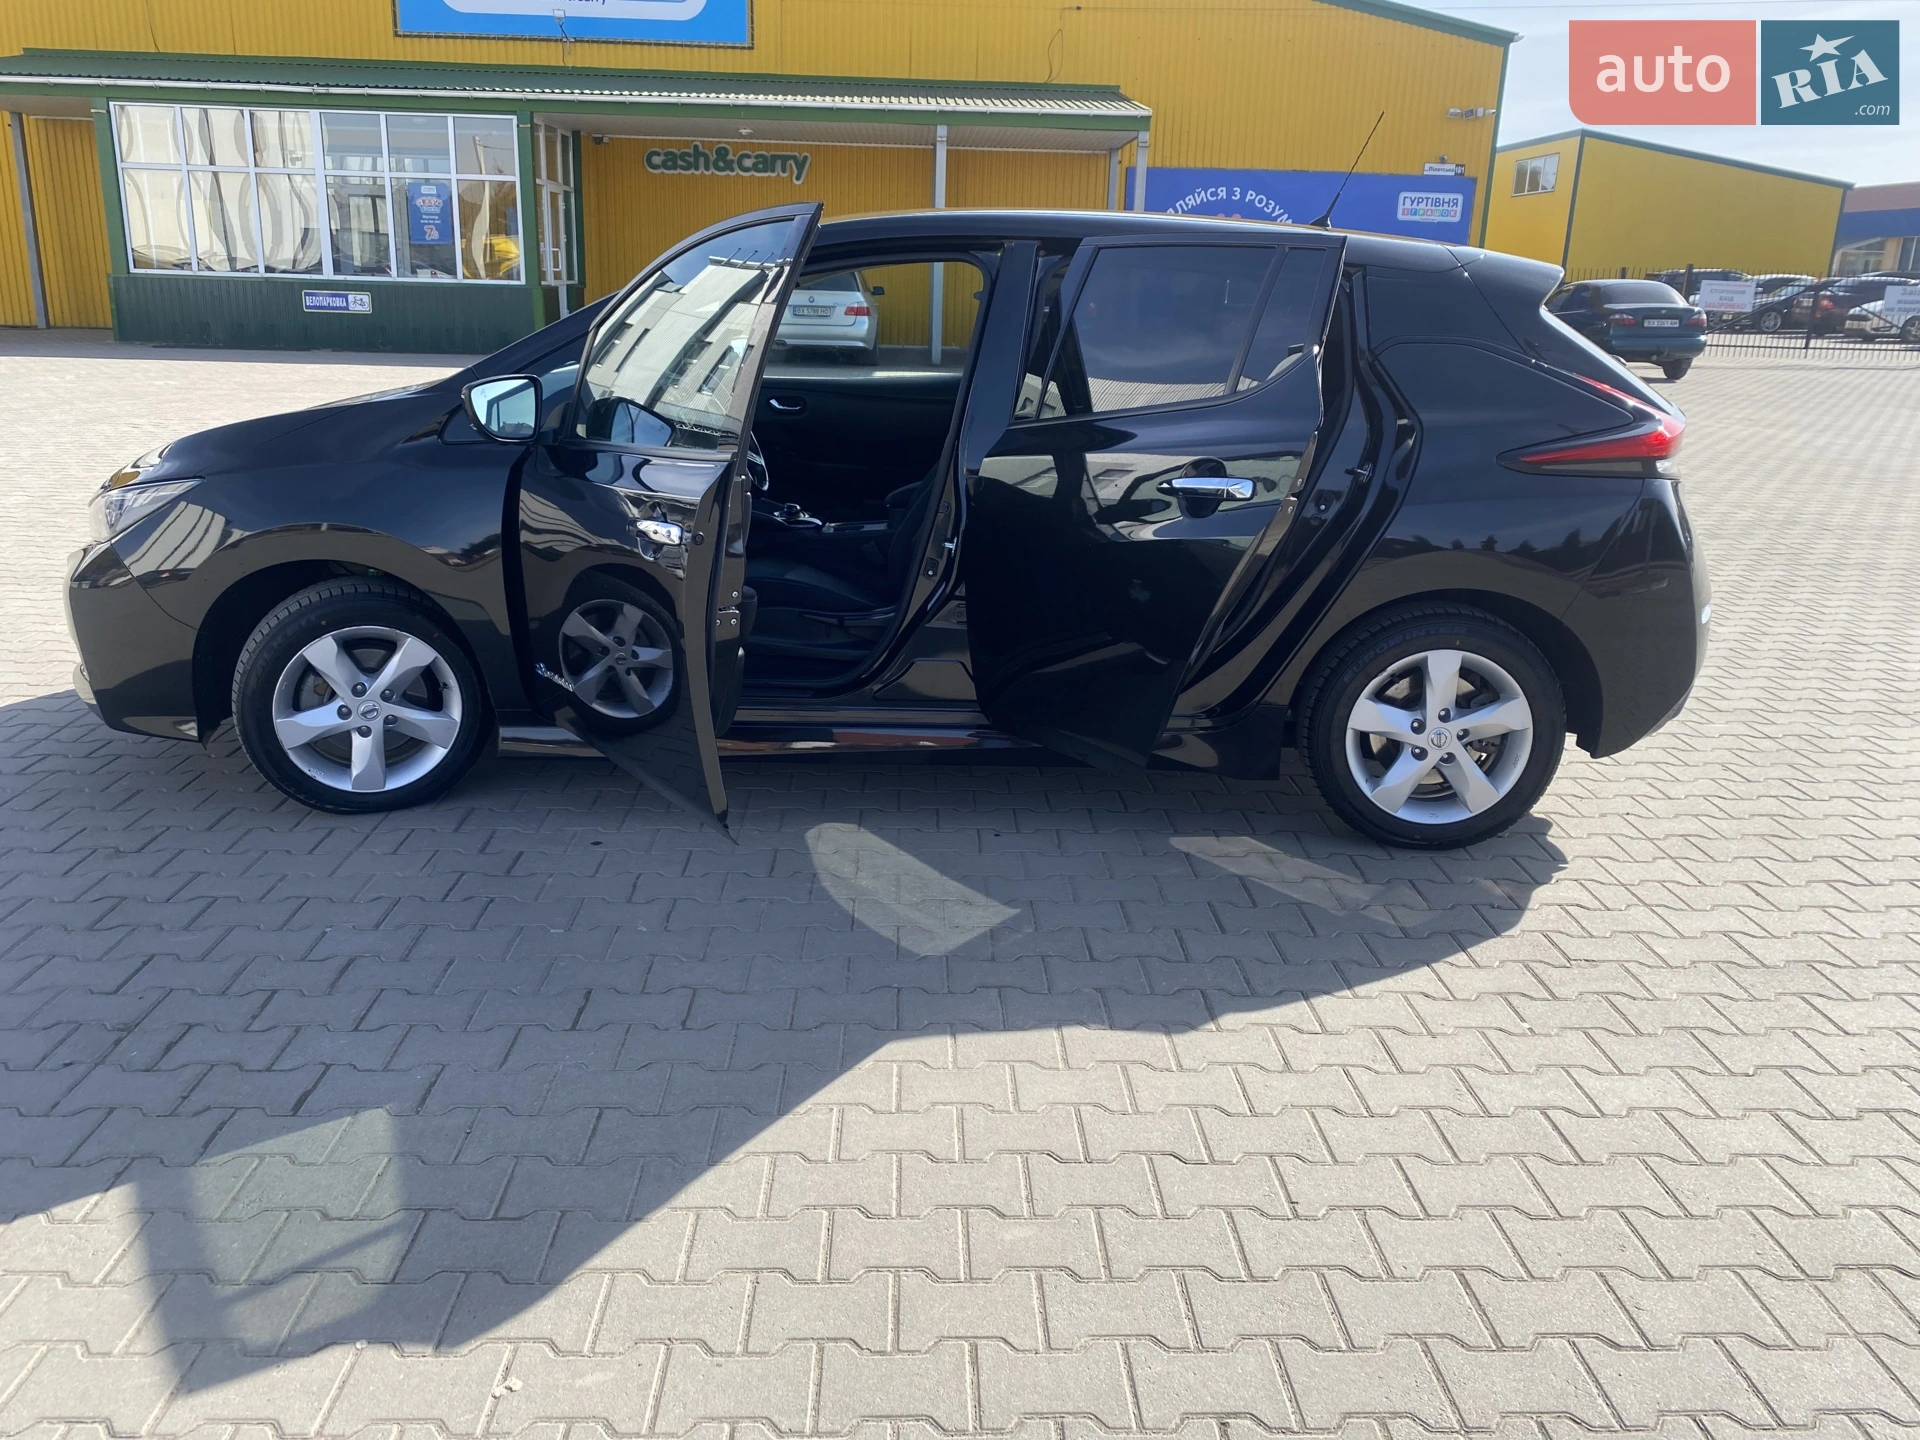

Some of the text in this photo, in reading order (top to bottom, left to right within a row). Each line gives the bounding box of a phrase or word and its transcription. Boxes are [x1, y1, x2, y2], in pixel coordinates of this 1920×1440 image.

[645, 143, 810, 182] cash&carry
[1402, 196, 1459, 208] ГУРТІВНЯ
[1402, 208, 1457, 217] ІГРАШОК
[305, 295, 347, 307] ВЕЛОПАРКОВКА
[1343, 626, 1467, 683] EUROWINTER
